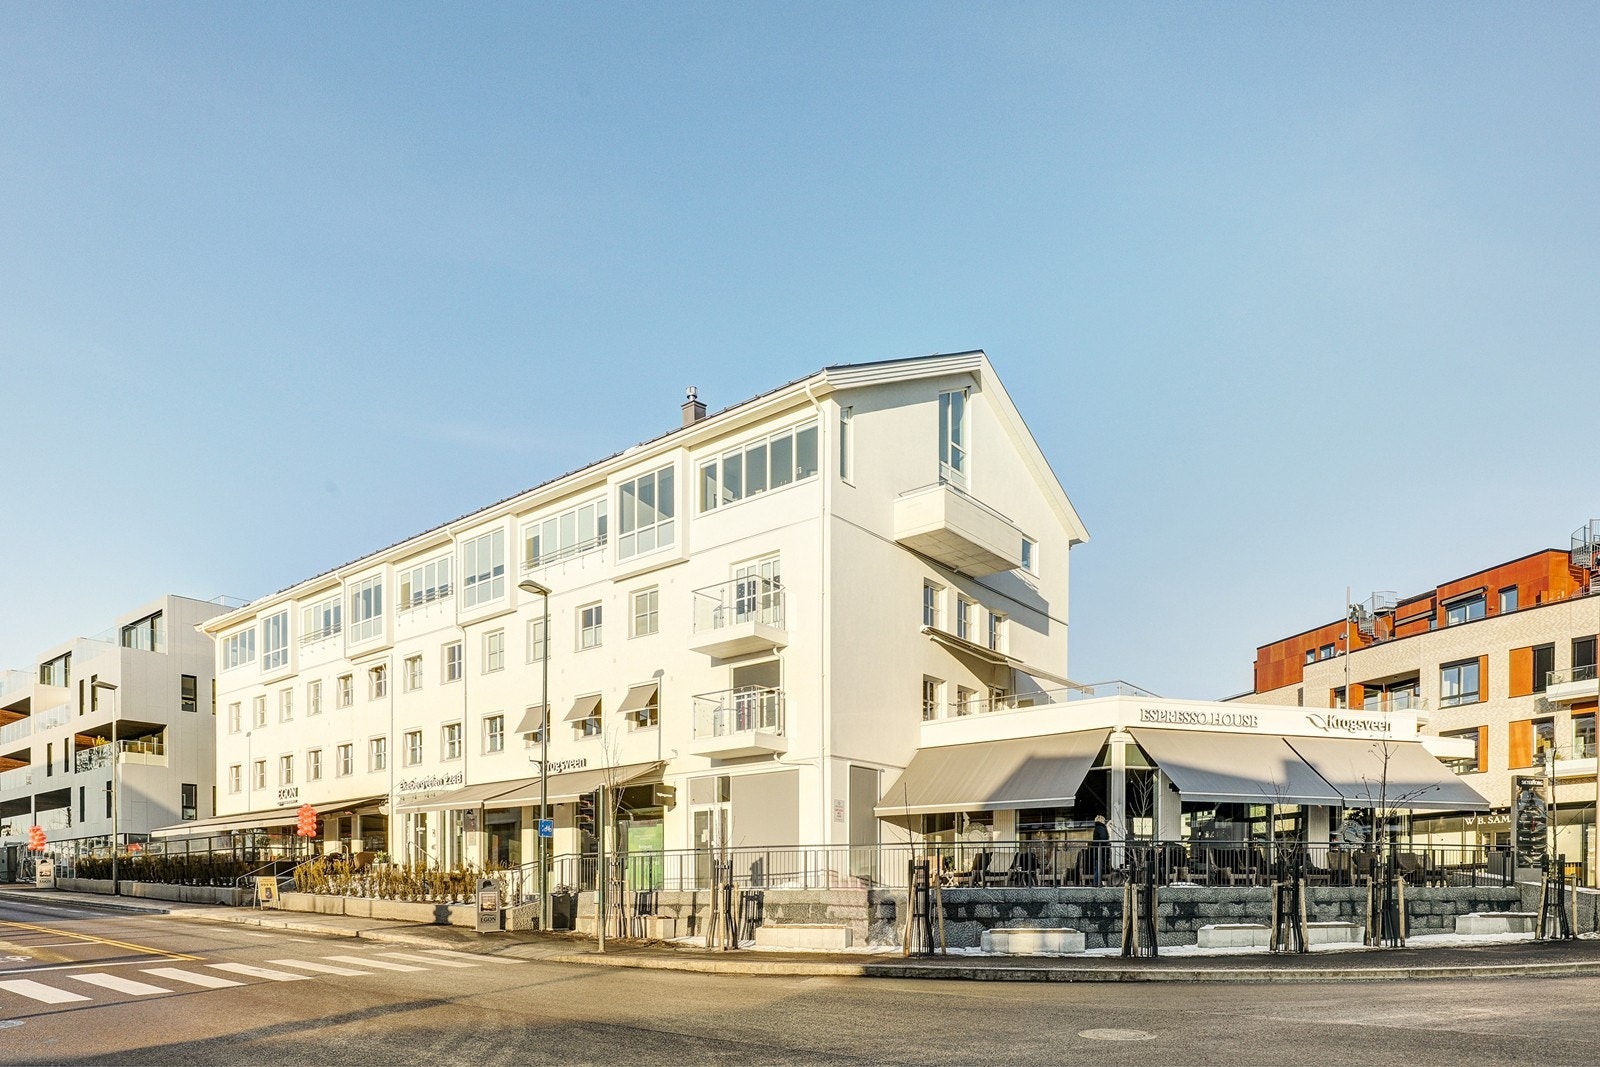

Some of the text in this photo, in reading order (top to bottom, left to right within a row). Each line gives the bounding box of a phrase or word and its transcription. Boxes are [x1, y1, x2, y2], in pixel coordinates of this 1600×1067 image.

[1140, 708, 1259, 728] ESPRESSO HOUSE
[1327, 714, 1391, 734] Krogsveen
[546, 758, 587, 773] rogsveen
[278, 787, 299, 800] EGON
